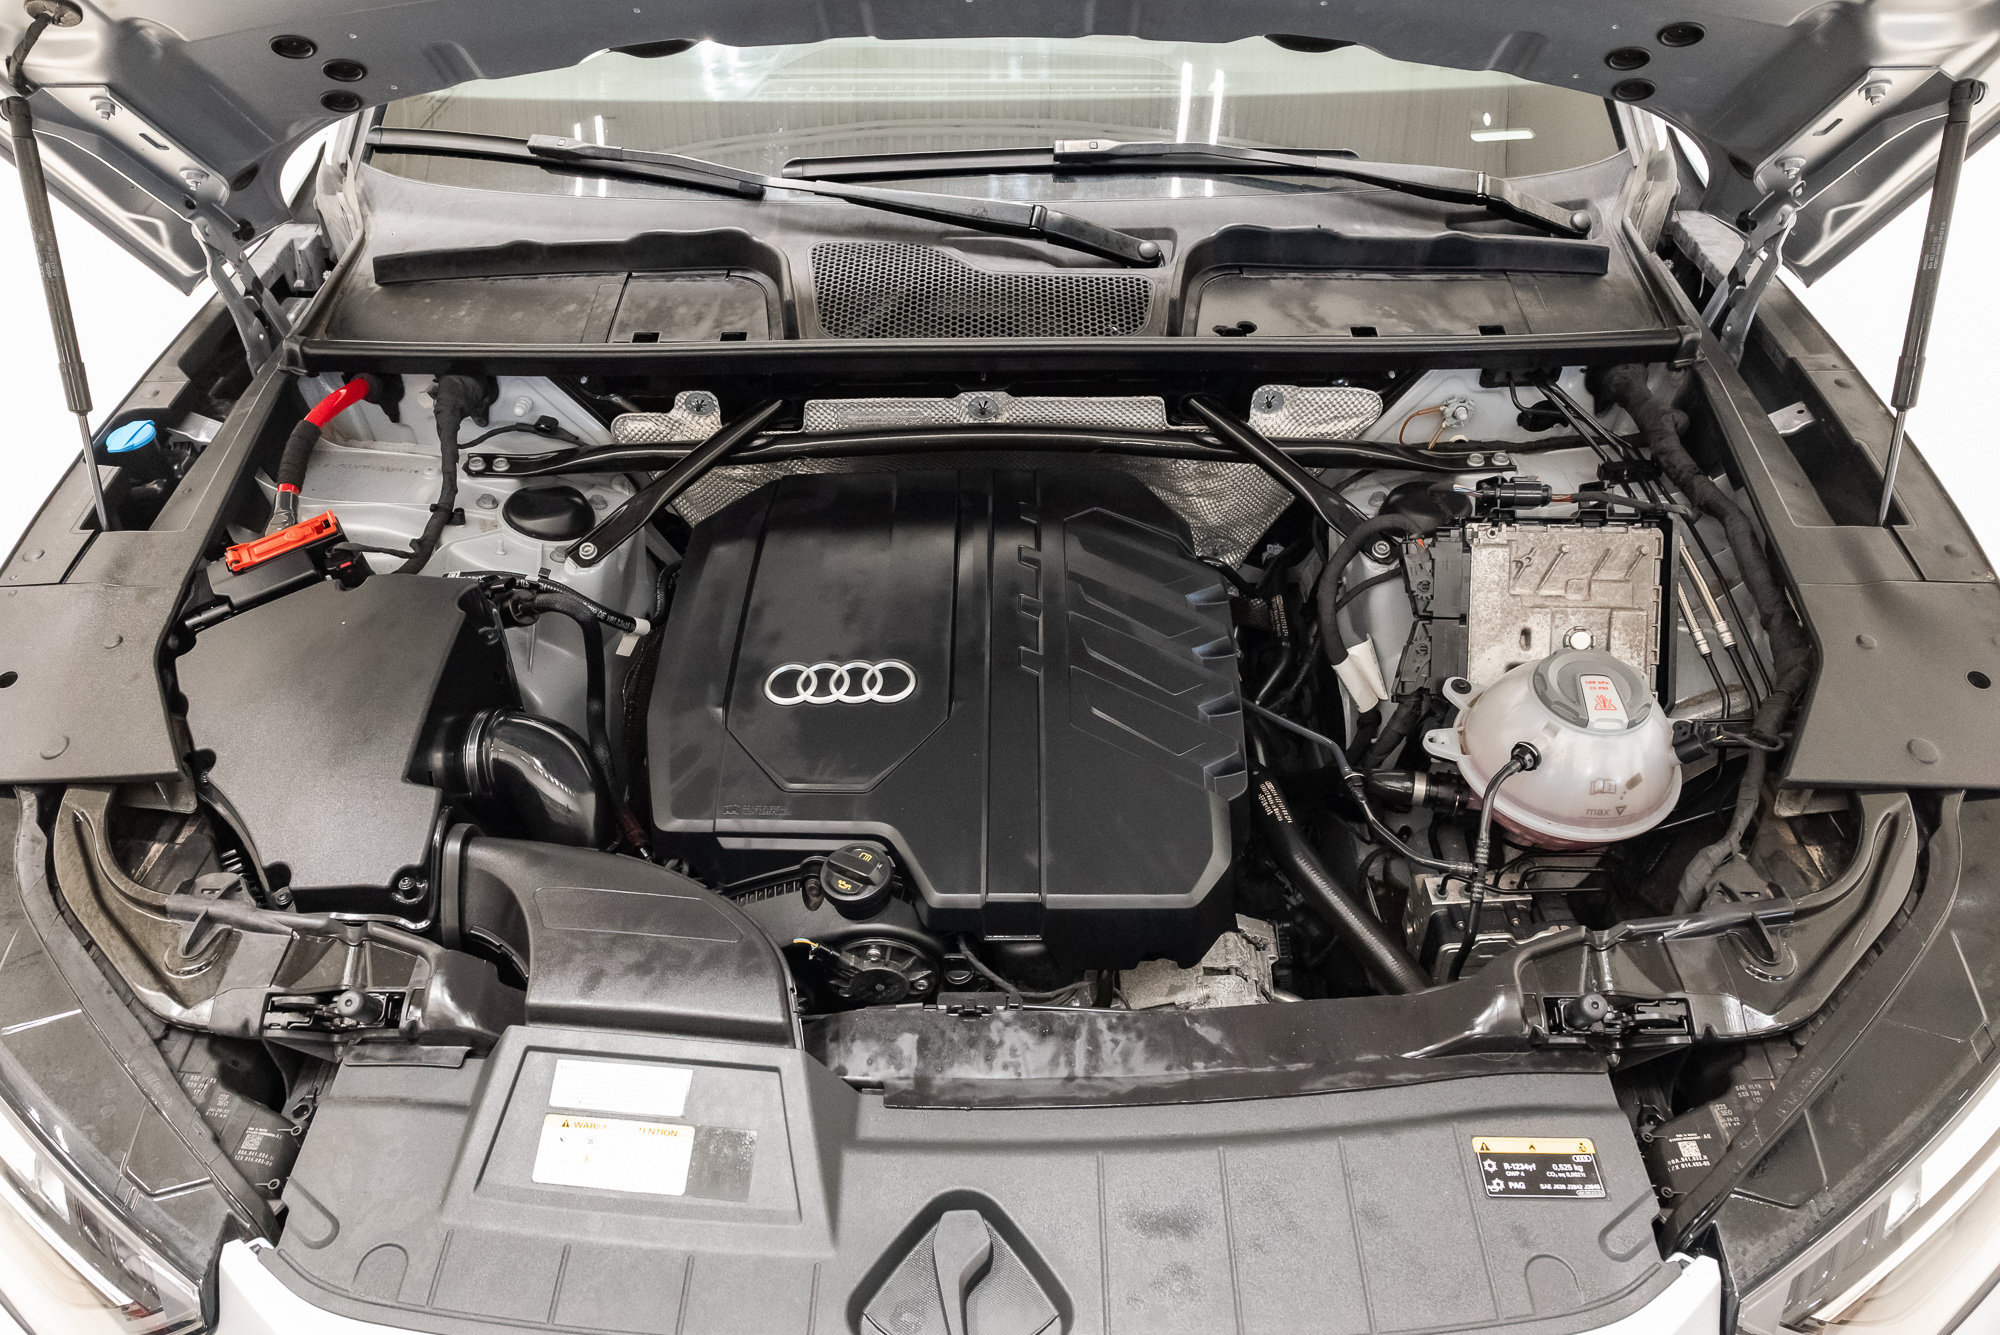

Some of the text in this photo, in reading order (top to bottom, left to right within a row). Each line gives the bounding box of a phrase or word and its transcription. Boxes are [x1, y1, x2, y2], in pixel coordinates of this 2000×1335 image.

[1586, 808, 1610, 816] max
[1503, 1163, 1536, 1172] R-1234yf
[1573, 1163, 1584, 1172] kg
